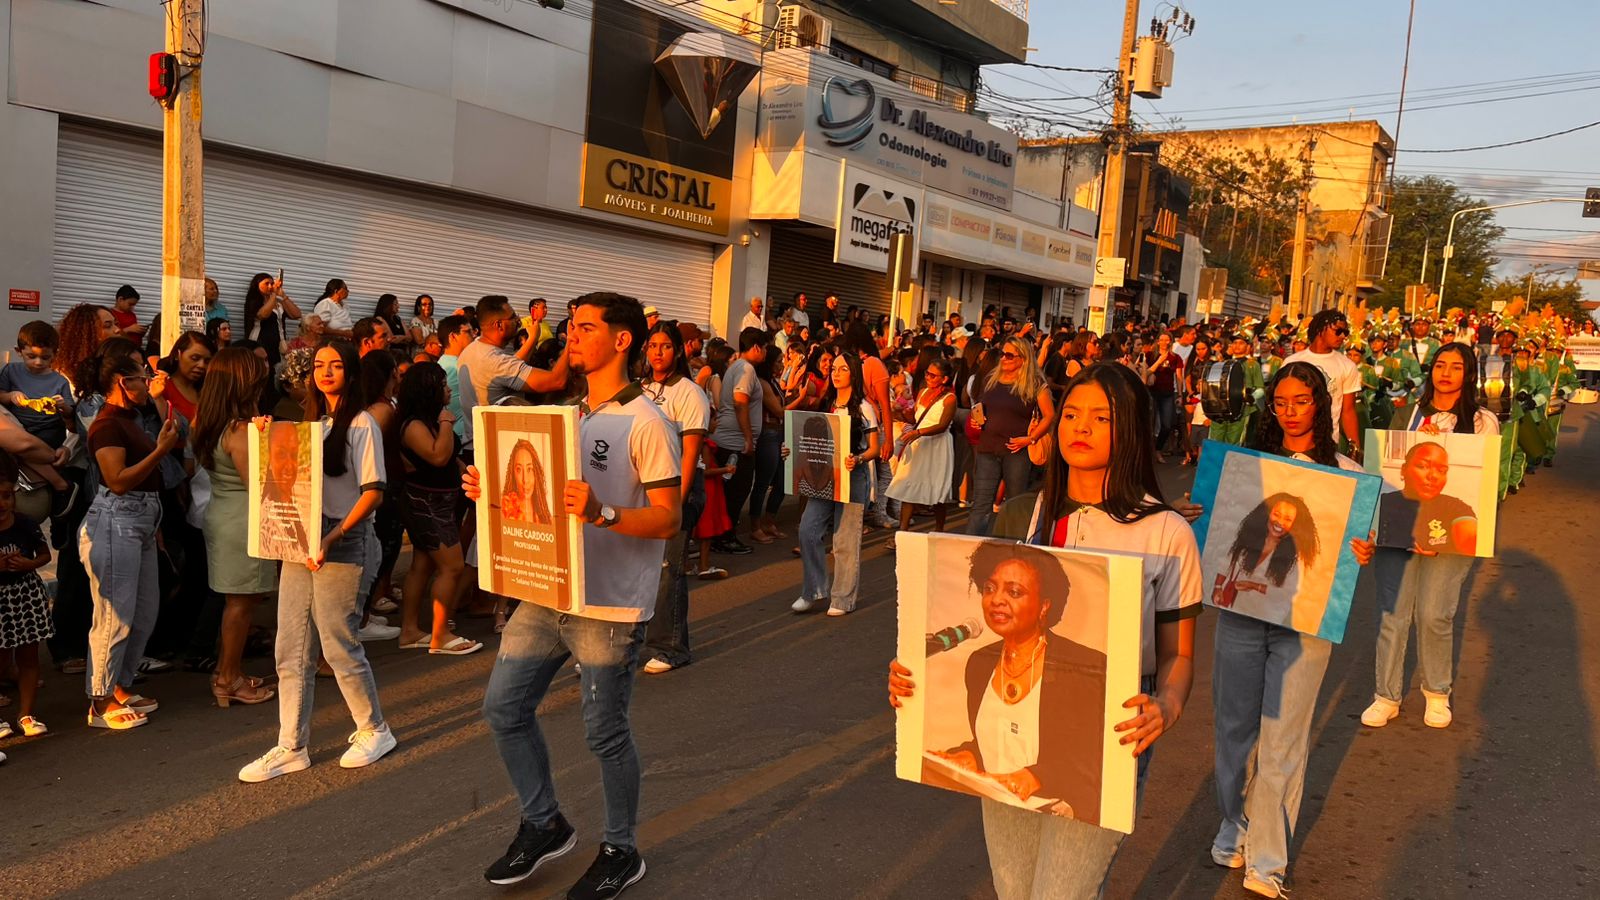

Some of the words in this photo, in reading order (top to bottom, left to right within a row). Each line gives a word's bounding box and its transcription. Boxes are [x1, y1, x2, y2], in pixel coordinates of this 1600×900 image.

[881, 97, 905, 126] Dr.
[908, 109, 986, 156] Alexandro
[987, 140, 1012, 167] Lira
[879, 132, 947, 168] Odontologia
[606, 158, 715, 210] CRISTAL
[604, 194, 647, 211] MÓVEIS
[650, 203, 656, 214] E
[661, 206, 713, 226] JOALHERIA
[503, 526, 523, 537] DALINE
[524, 529, 554, 543] CARDOSO
[513, 541, 540, 552] PROFESSORA
